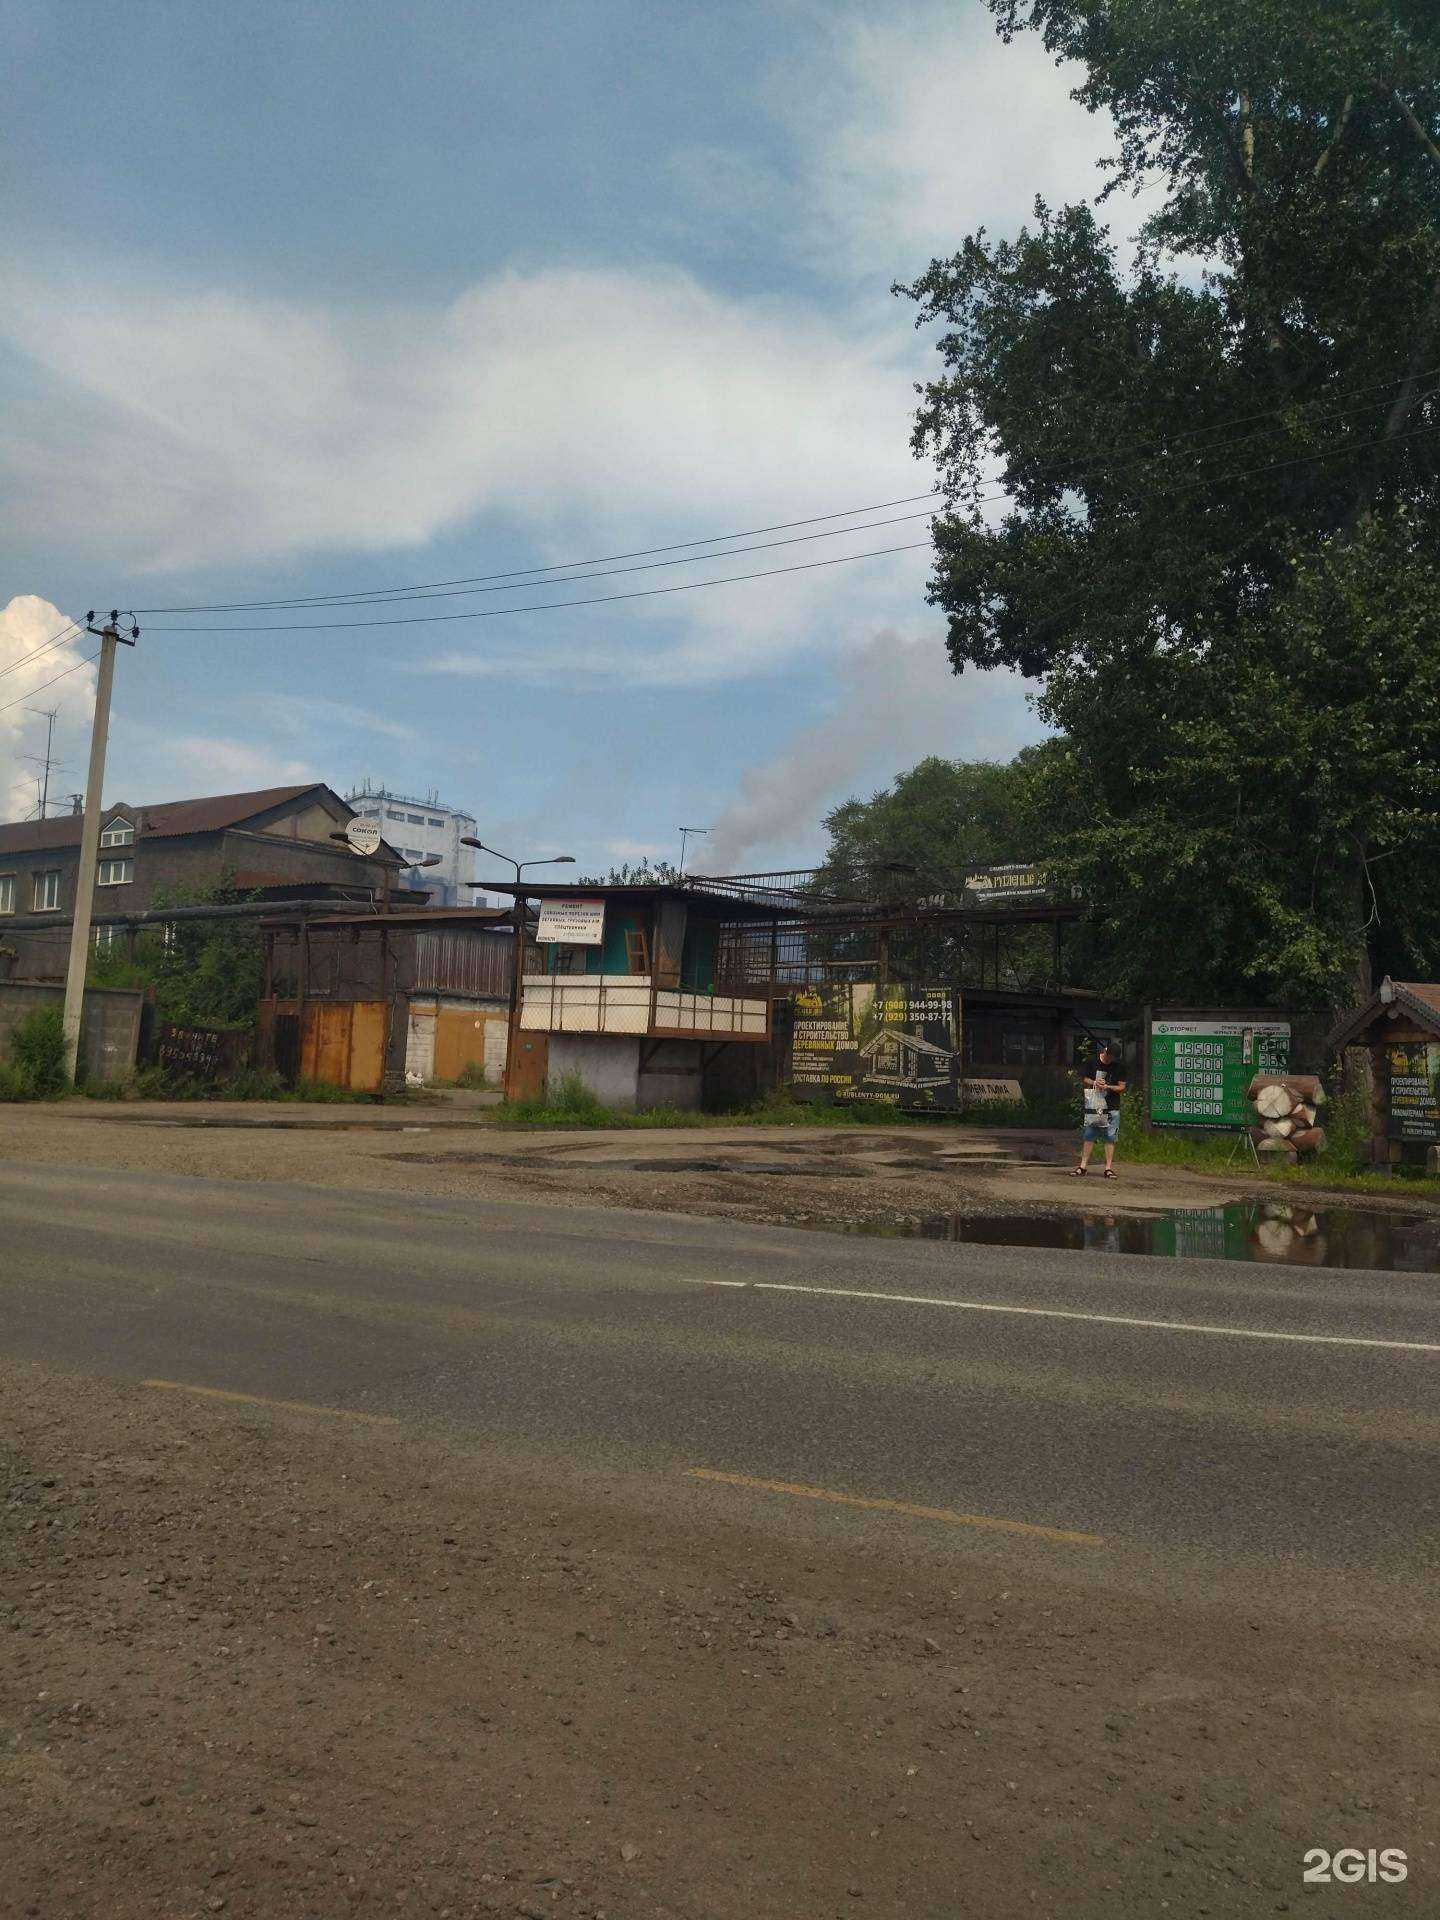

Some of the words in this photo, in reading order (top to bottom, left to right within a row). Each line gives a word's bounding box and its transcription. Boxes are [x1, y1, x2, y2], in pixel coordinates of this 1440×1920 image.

[872, 1001, 884, 1010] +7
[908, 1000, 953, 1010] 944-99-98
[872, 1012, 884, 1021] +7
[885, 1012, 907, 1022] (929)
[909, 1012, 953, 1021] 350-87-72
[793, 1021, 849, 1031] ПРОЕКТИРОВАНИЕ
[793, 1031, 798, 1039] И
[799, 1031, 849, 1040] СТРОИТЕЛЬСТВО
[792, 1041, 835, 1051] ДЕРЕВЯННЫХ
[836, 1041, 859, 1050] ДОМОВ
[830, 1074, 852, 1084] РОССИИ
